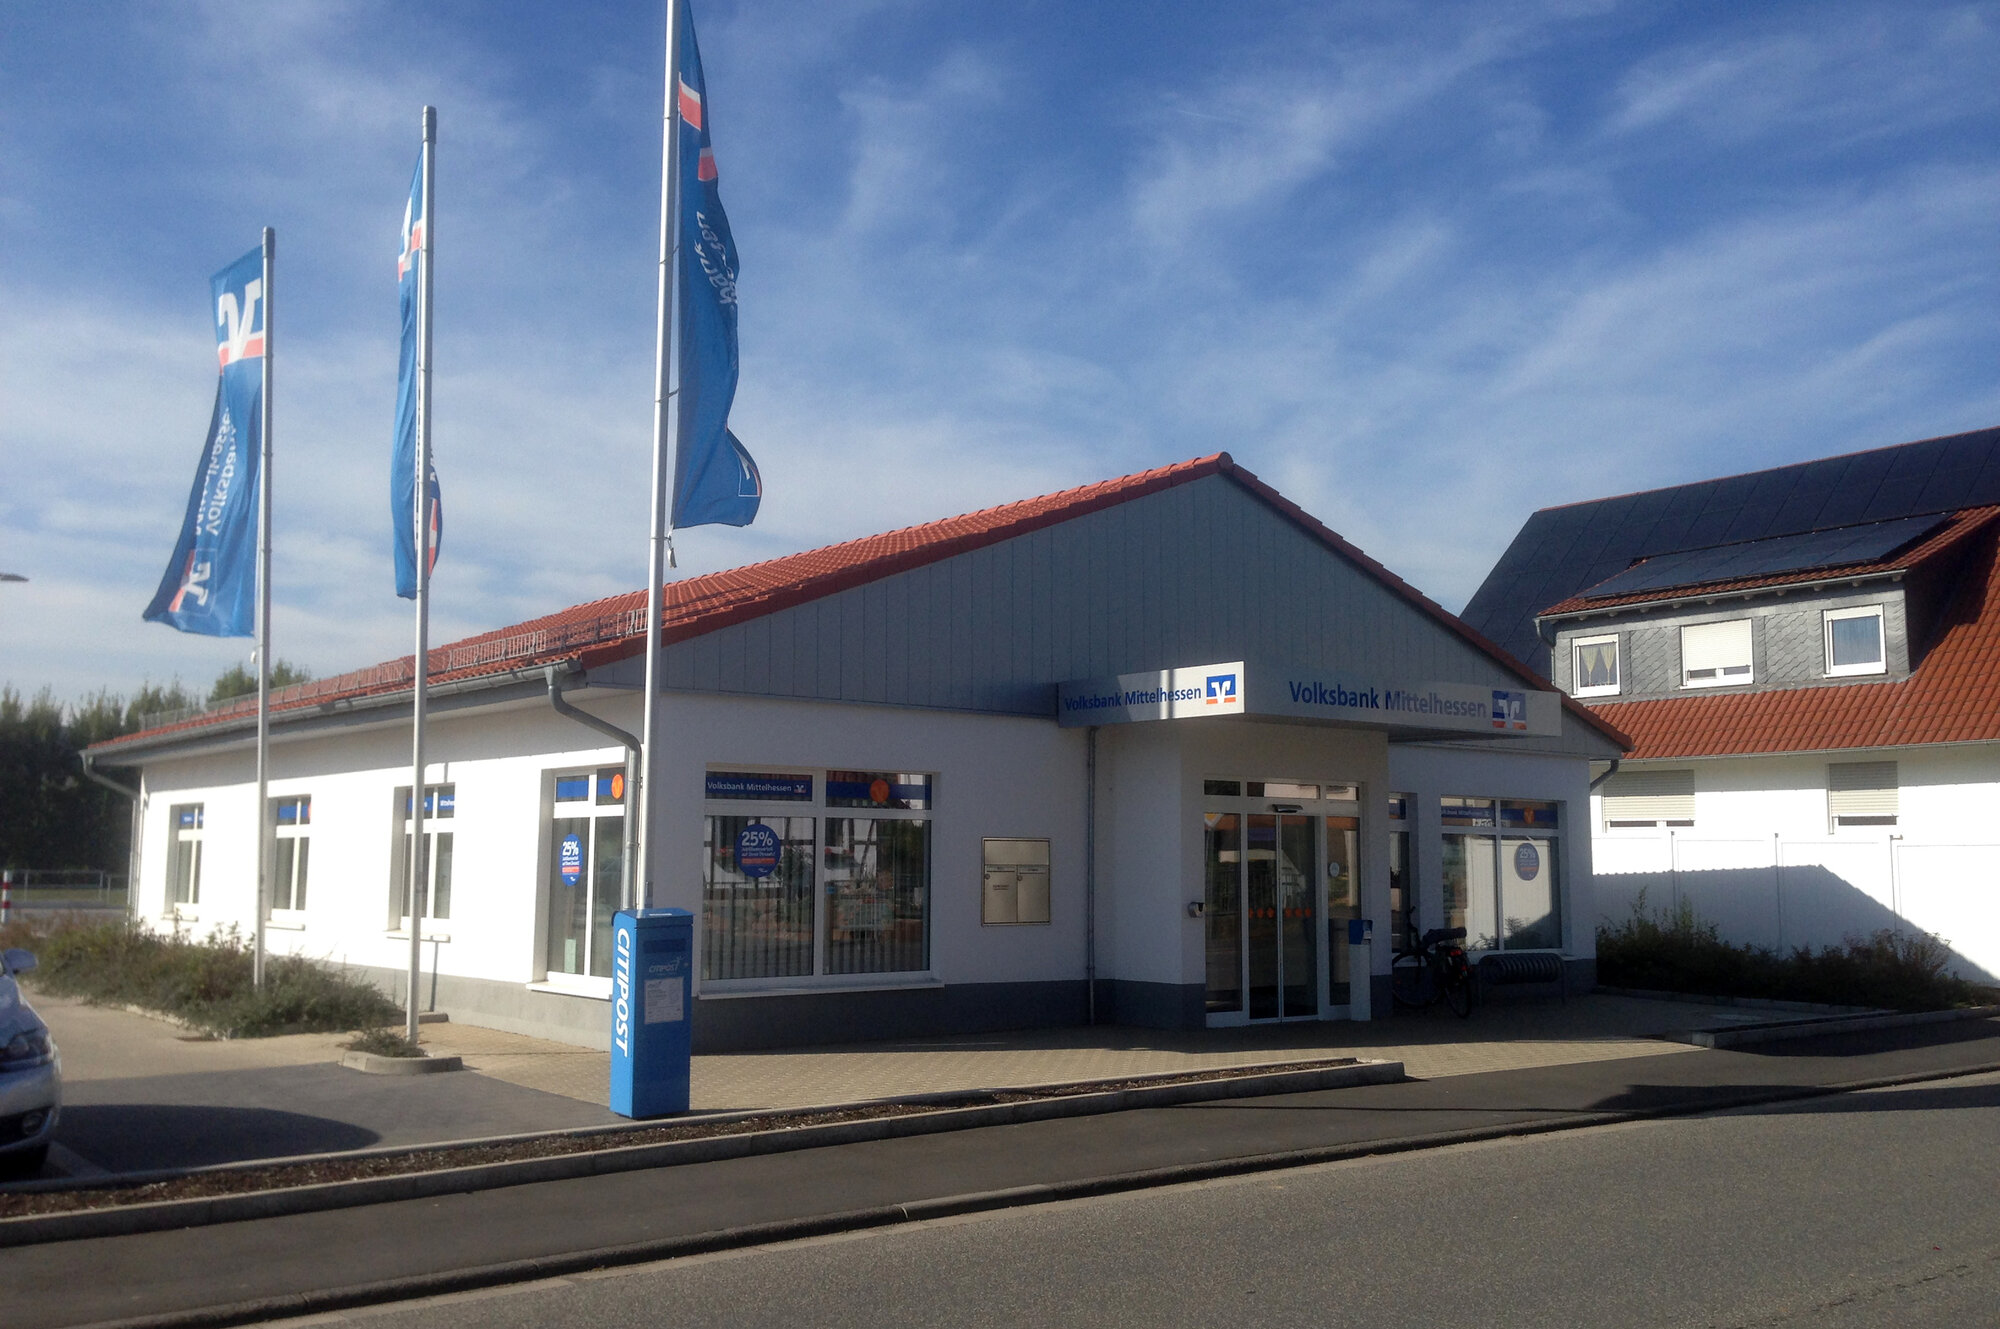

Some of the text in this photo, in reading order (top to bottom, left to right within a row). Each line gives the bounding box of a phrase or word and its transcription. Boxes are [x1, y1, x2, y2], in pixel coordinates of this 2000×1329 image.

[1065, 687, 1201, 711] Volksbank Mittelhessen
[1289, 681, 1487, 717] Volksbank Mittelhessen
[707, 782, 792, 792] Volksbank Mittelhessen
[562, 840, 579, 856] 25%
[741, 831, 773, 846] 25%
[615, 927, 630, 1057] CITIPOST
